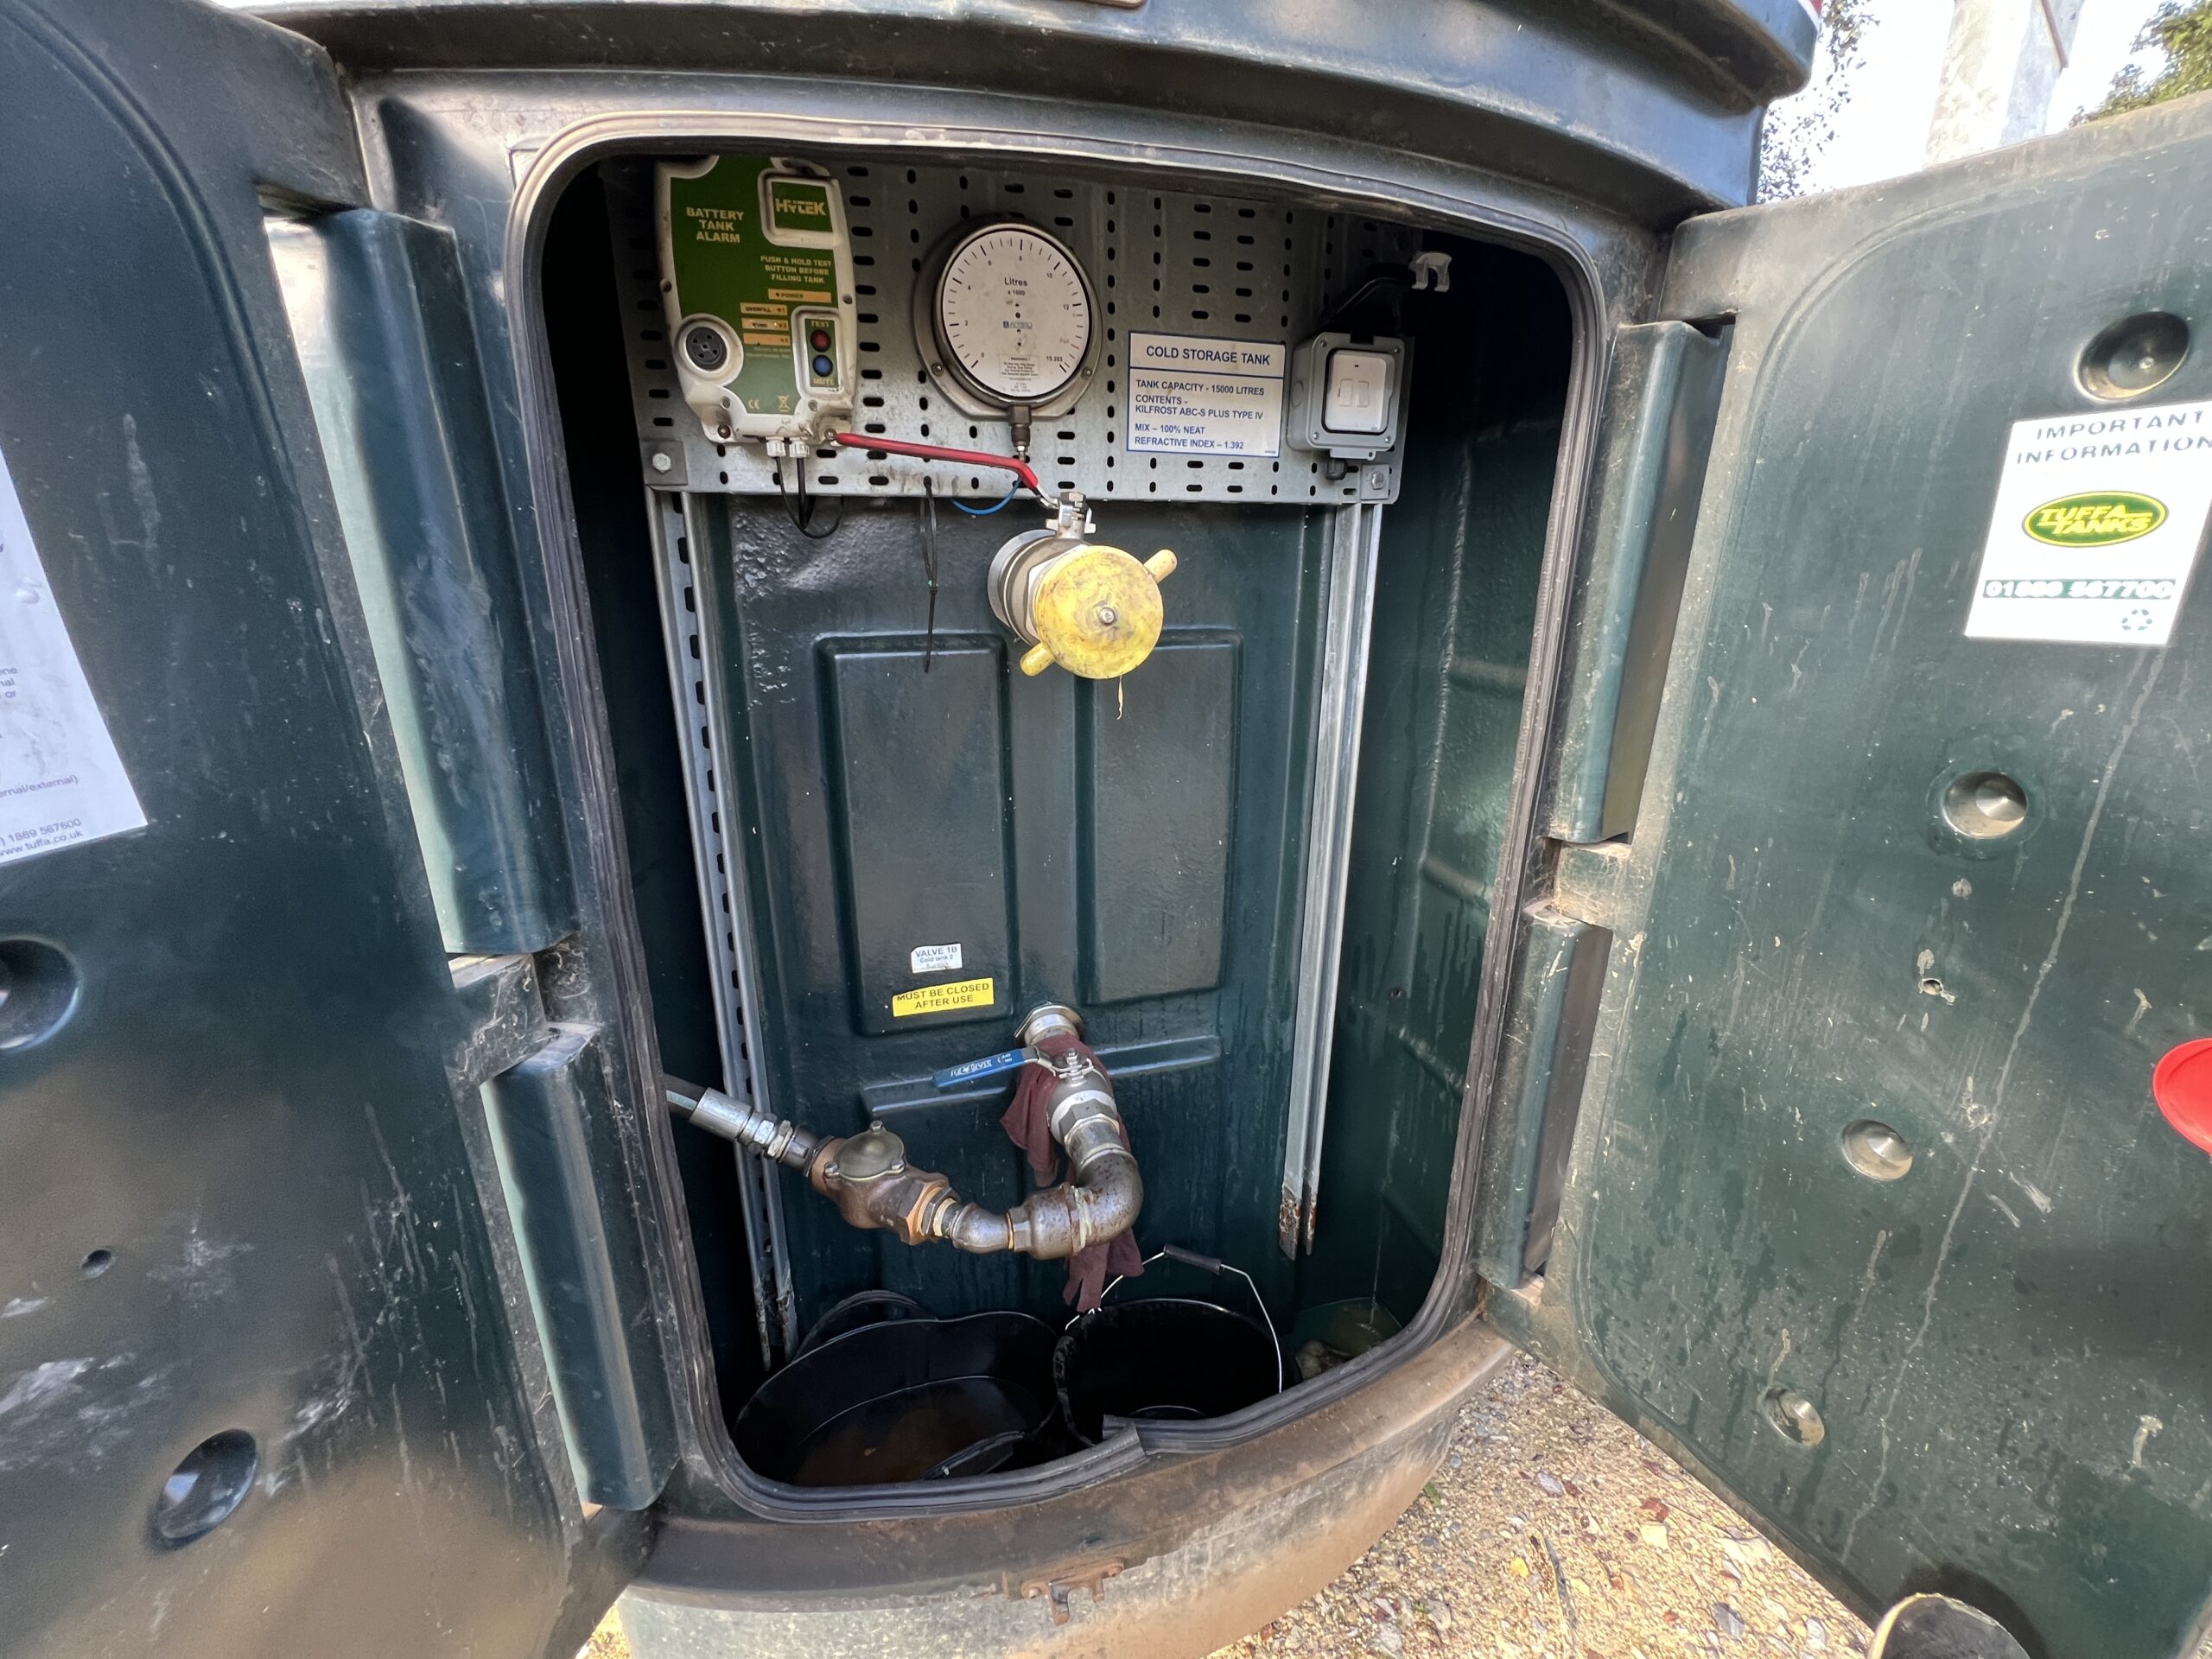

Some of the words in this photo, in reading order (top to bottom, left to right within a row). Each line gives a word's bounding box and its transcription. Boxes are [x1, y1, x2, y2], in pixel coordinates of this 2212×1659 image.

[686, 207, 744, 221] BATTERY
[699, 219, 734, 232] TANK
[696, 232, 741, 243] ALARM
[760, 255, 781, 264] PUSH
[791, 257, 812, 266] HOLD
[765, 264, 797, 273] BUTTON
[798, 267, 830, 276] BEFORE
[1004, 276, 1028, 287] Litres
[1147, 346, 1179, 359] COLD
[1182, 348, 1237, 363] STORAGE
[1241, 353, 1270, 365] TANK
[1135, 379, 1159, 389] TANK
[1161, 381, 1204, 391] CAPACITY
[1211, 385, 1234, 394] 15000
[1236, 386, 1264, 396] LITRES
[1135, 394, 1182, 405] CONTENTS
[1135, 404, 1178, 416] KILFROST
[1179, 407, 1205, 417] ABC-S
[1208, 409, 1230, 418] PLUS
[1232, 410, 1253, 420] TYPE
[1135, 423, 1150, 432] MIX
[1160, 424, 1181, 434] 100%
[1183, 425, 1205, 435] NEAT
[2036, 410, 2204, 441] IMPORTANT
[1135, 436, 1187, 448] REFRACTIVE
[1190, 438, 1215, 448] INDEX
[1224, 441, 1244, 449] 1.392
[2017, 435, 2212, 464] INFORMATION
[2039, 504, 2153, 522] TUFFA
[2037, 518, 2152, 535] TANKS
[9, 829, 37, 842] 1889
[40, 818, 81, 835] 567600
[915, 947, 944, 957] VALVE
[897, 990, 926, 1001] MUST
[930, 988, 944, 997] BE
[946, 982, 989, 995] CLOSED
[915, 998, 949, 1008] AFTER
[952, 995, 974, 1004] USE
